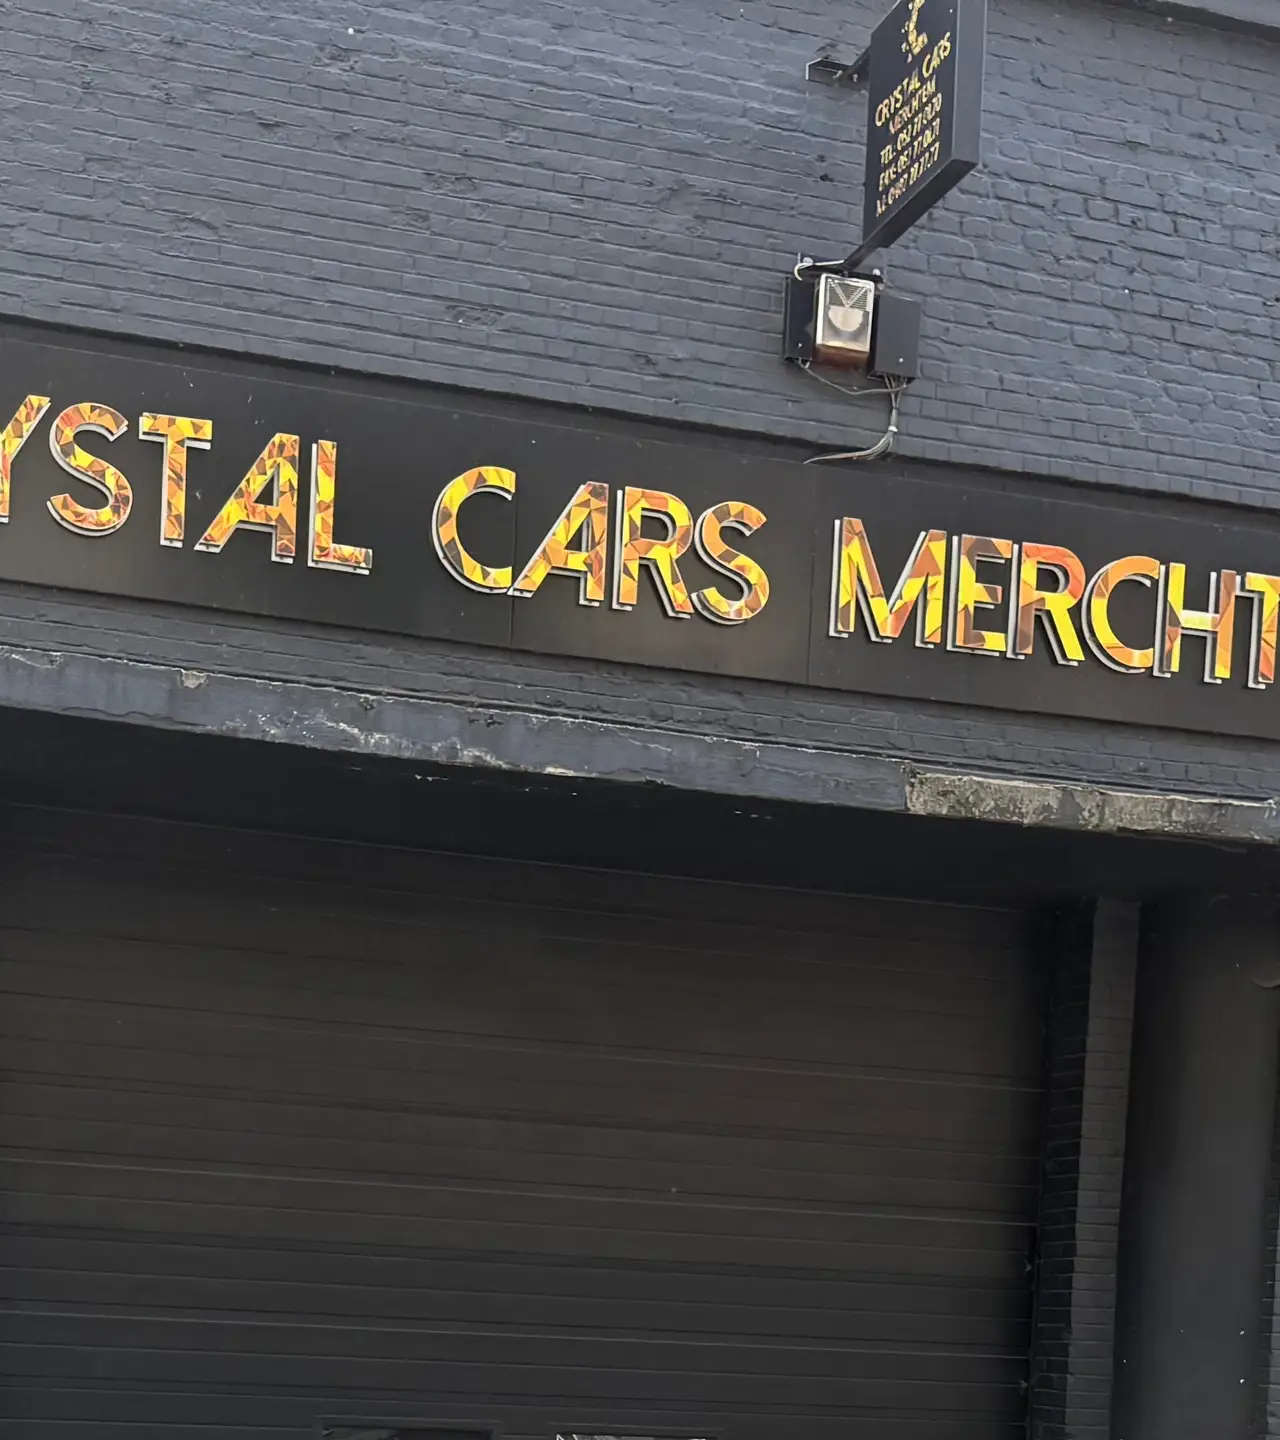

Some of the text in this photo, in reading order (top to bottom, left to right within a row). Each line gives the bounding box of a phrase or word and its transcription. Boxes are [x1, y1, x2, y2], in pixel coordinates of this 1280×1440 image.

[875, 32, 951, 127] CRYSTAL CARS
[431, 465, 771, 625] CARS
